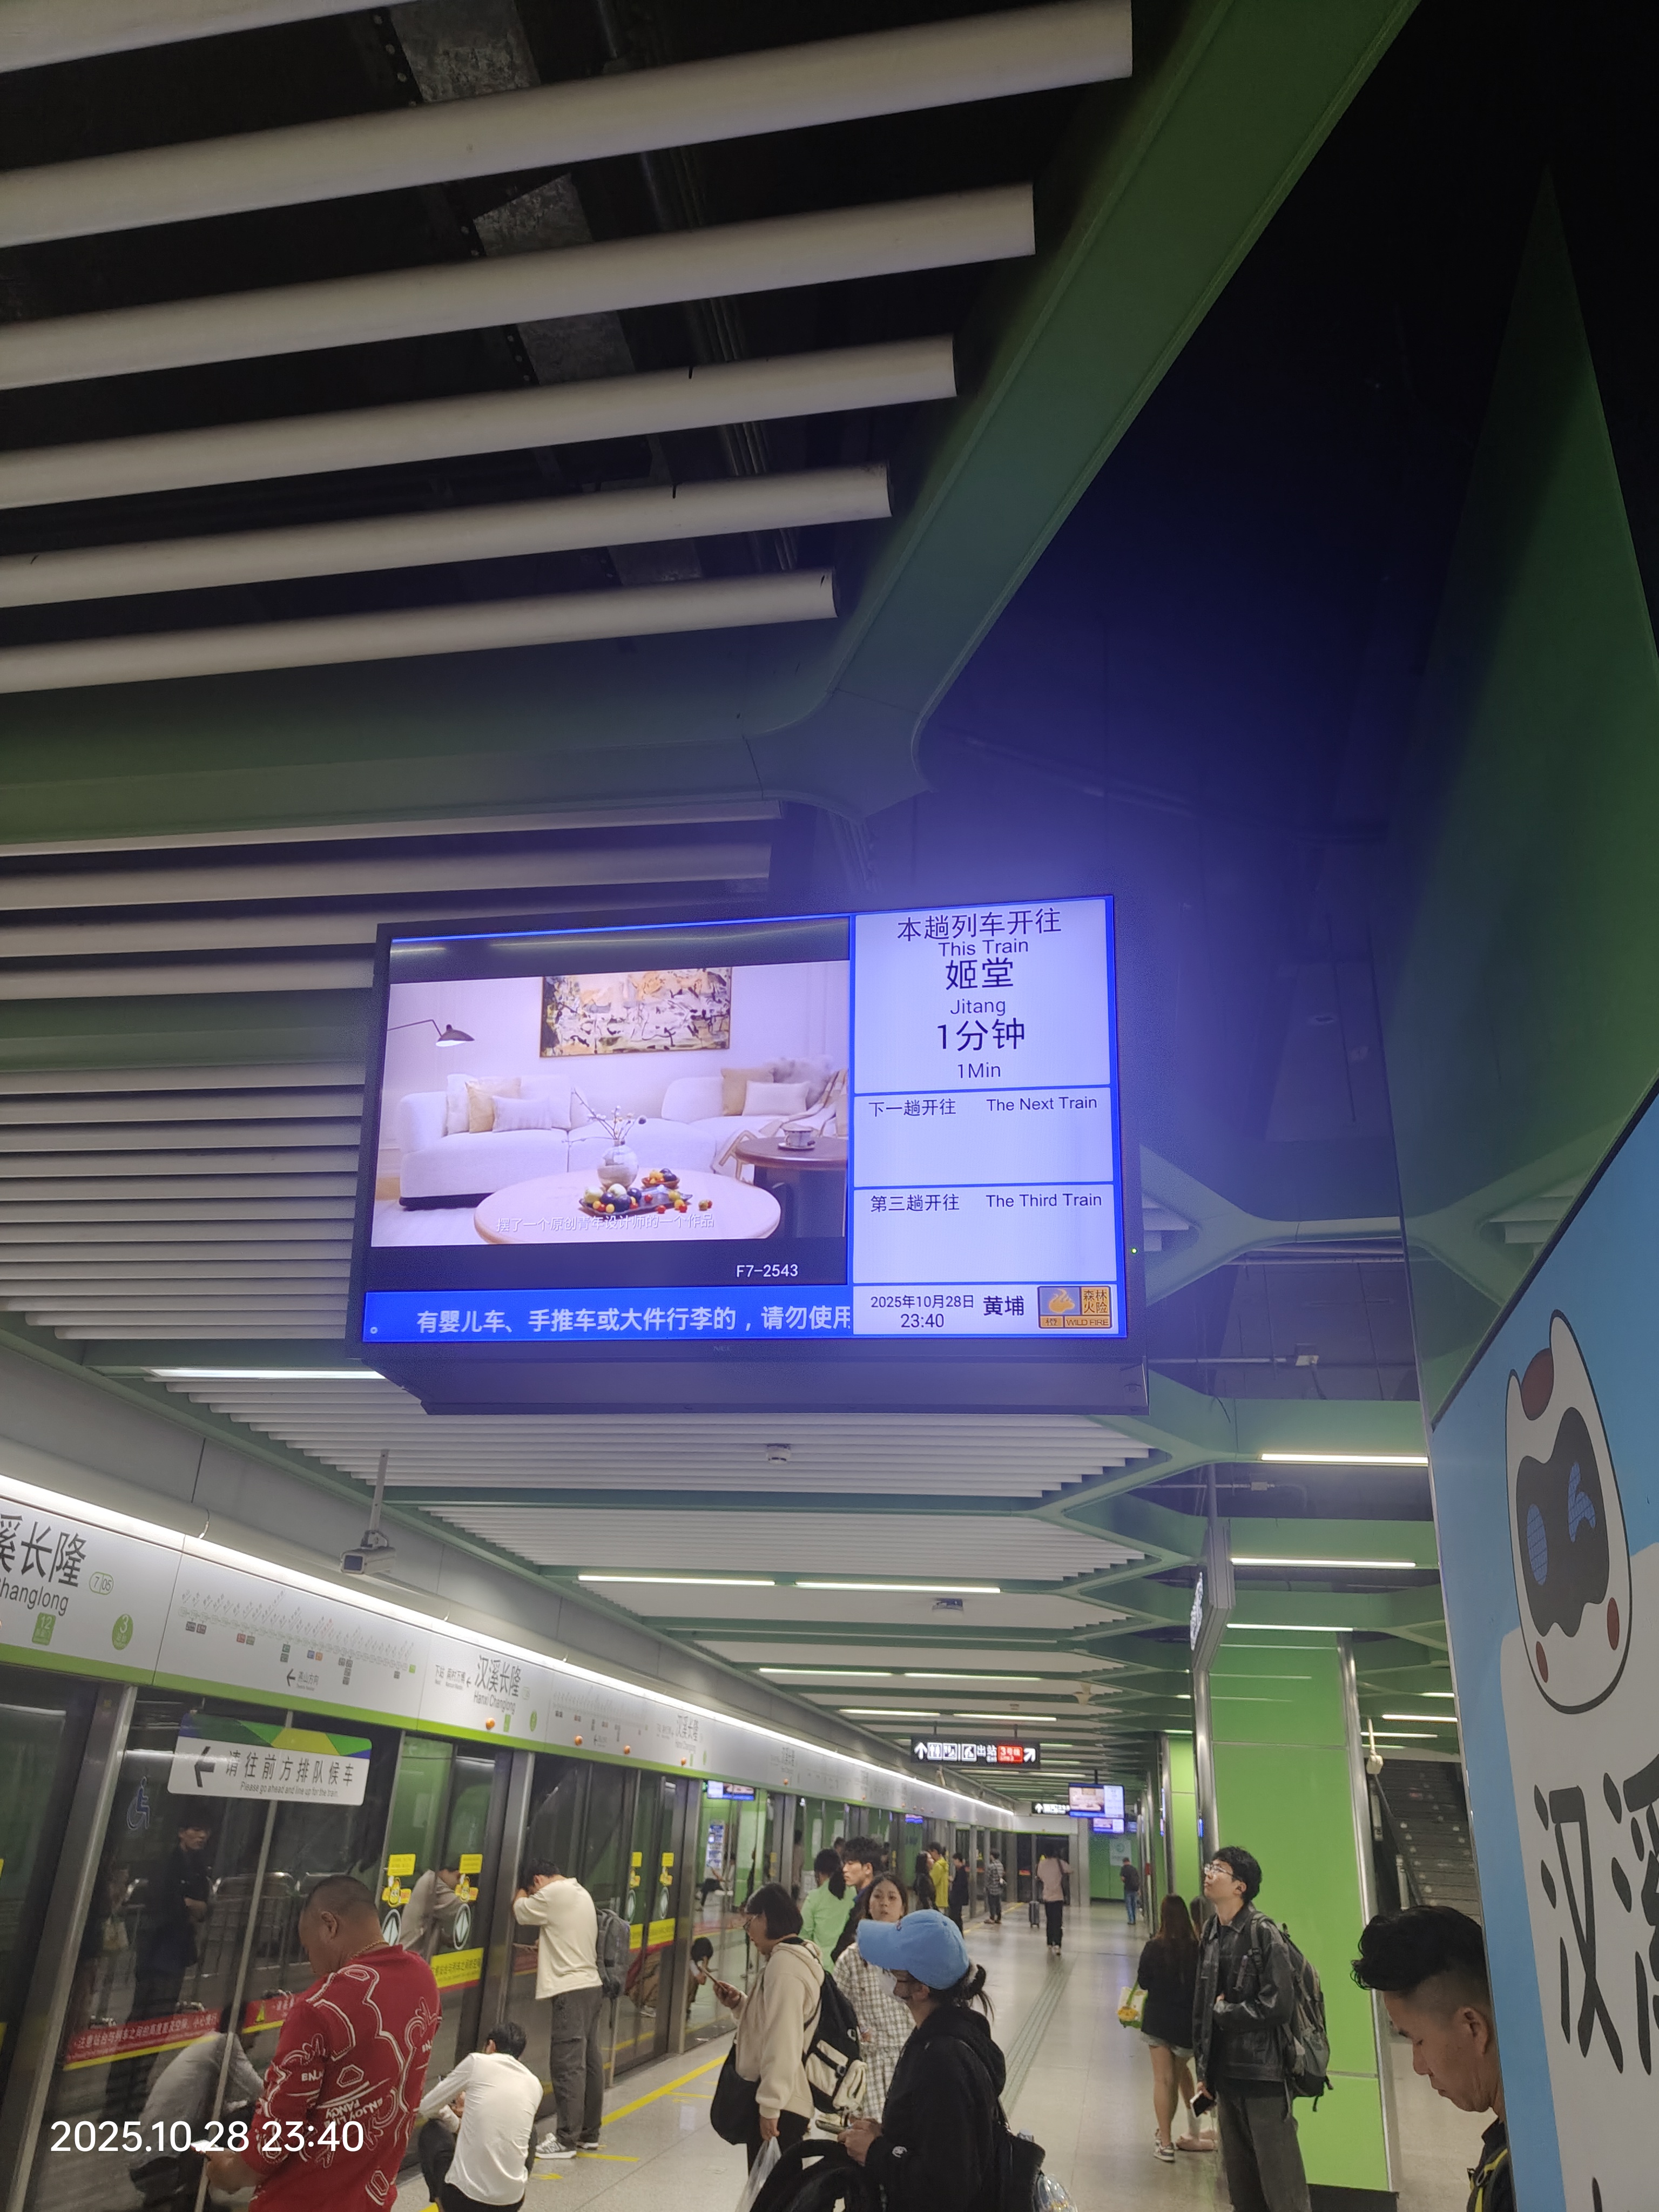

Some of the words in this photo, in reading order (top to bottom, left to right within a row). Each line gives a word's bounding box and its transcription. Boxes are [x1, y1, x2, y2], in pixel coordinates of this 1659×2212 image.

[897, 907, 1062, 942] 本趟列车开往
[939, 942, 975, 956] This
[982, 939, 1029, 954] Train
[946, 957, 1014, 990] 姬堂
[950, 999, 1006, 1016] Jitang
[938, 1017, 1025, 1051] 1分钟
[957, 1062, 1001, 1079] 1Min
[868, 1098, 956, 1117] 下一趟开往
[987, 1098, 1014, 1111] The
[1020, 1097, 1054, 1110] Next
[1058, 1096, 1097, 1109] Train
[870, 1193, 960, 1212] 第三趟开往
[986, 1195, 1014, 1208] The
[1020, 1193, 1057, 1207] Third
[1062, 1193, 1102, 1206] Train
[496, 1215, 714, 1232] 摆了一个原创青年设计师的一个作品
[736, 1264, 799, 1278] F7-2543
[871, 1294, 974, 1309] 2025年10月28日
[1083, 1290, 1107, 1301] 森林
[983, 1296, 1024, 1316] 黄埔
[1084, 1301, 1107, 1313] 火险
[901, 1313, 945, 1328] 23:40
[0, 1577, 69, 1616] hanglong
[120, 1615, 129, 1634] 3
[474, 1654, 522, 1697] 汉溪长隆
[977, 1745, 997, 1757] 出站
[226, 1749, 354, 1786] 请往前方排队候车
[323, 2115, 347, 2129] LIE
